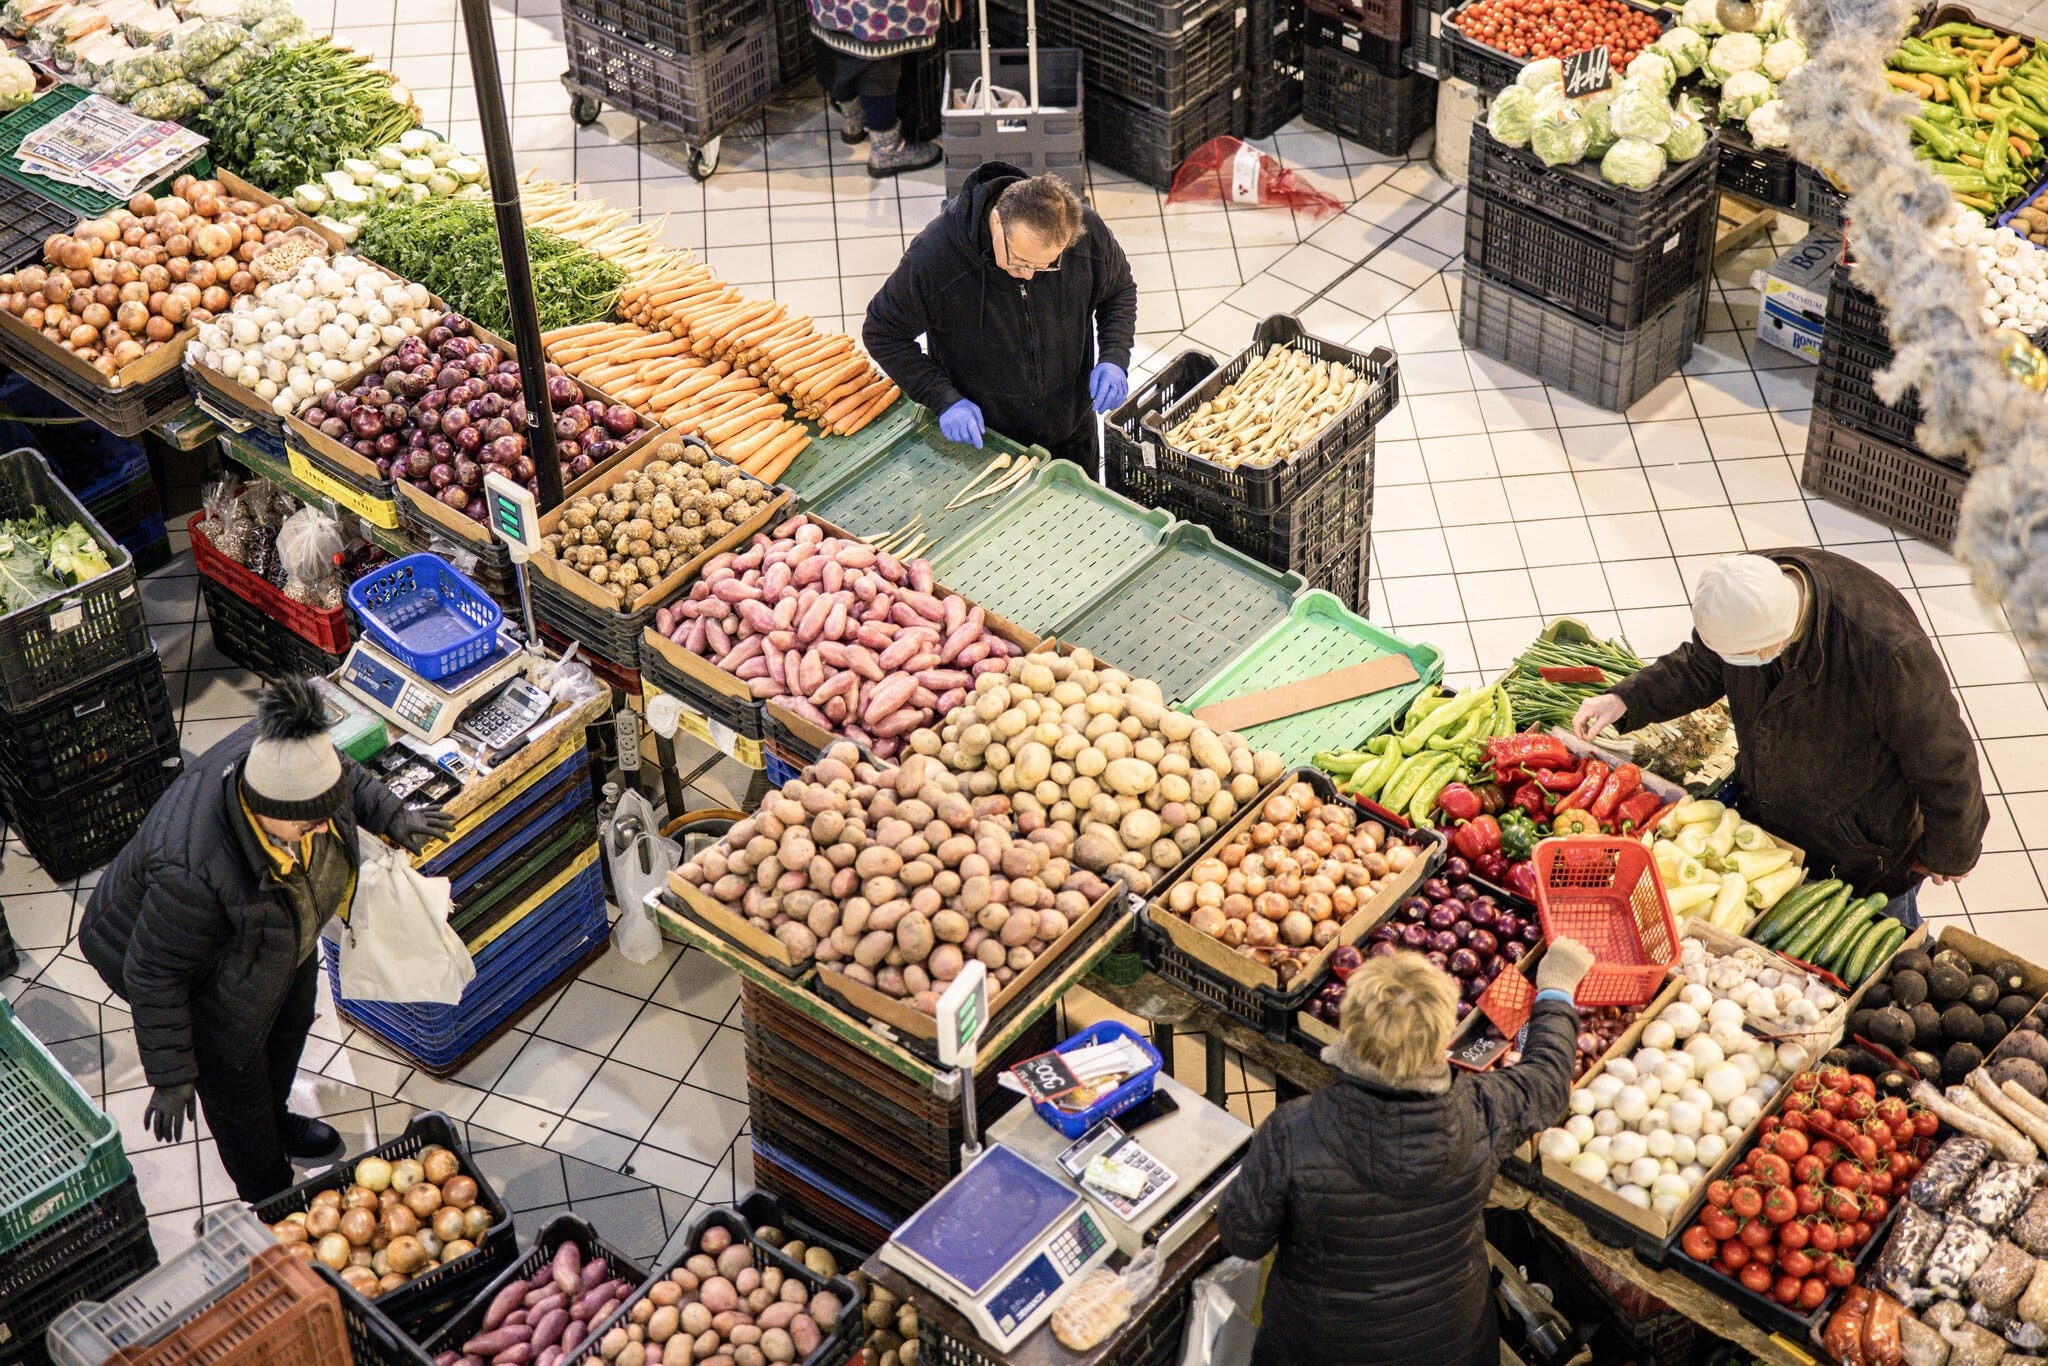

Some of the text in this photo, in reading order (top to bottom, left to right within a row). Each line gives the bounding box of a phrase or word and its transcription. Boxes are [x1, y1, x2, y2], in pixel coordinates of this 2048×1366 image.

[1566, 45, 1609, 93] 449
[1787, 291, 1823, 309] PREMIUM
[1463, 1044, 1485, 1061] 200
[1035, 1065, 1065, 1089] 300
